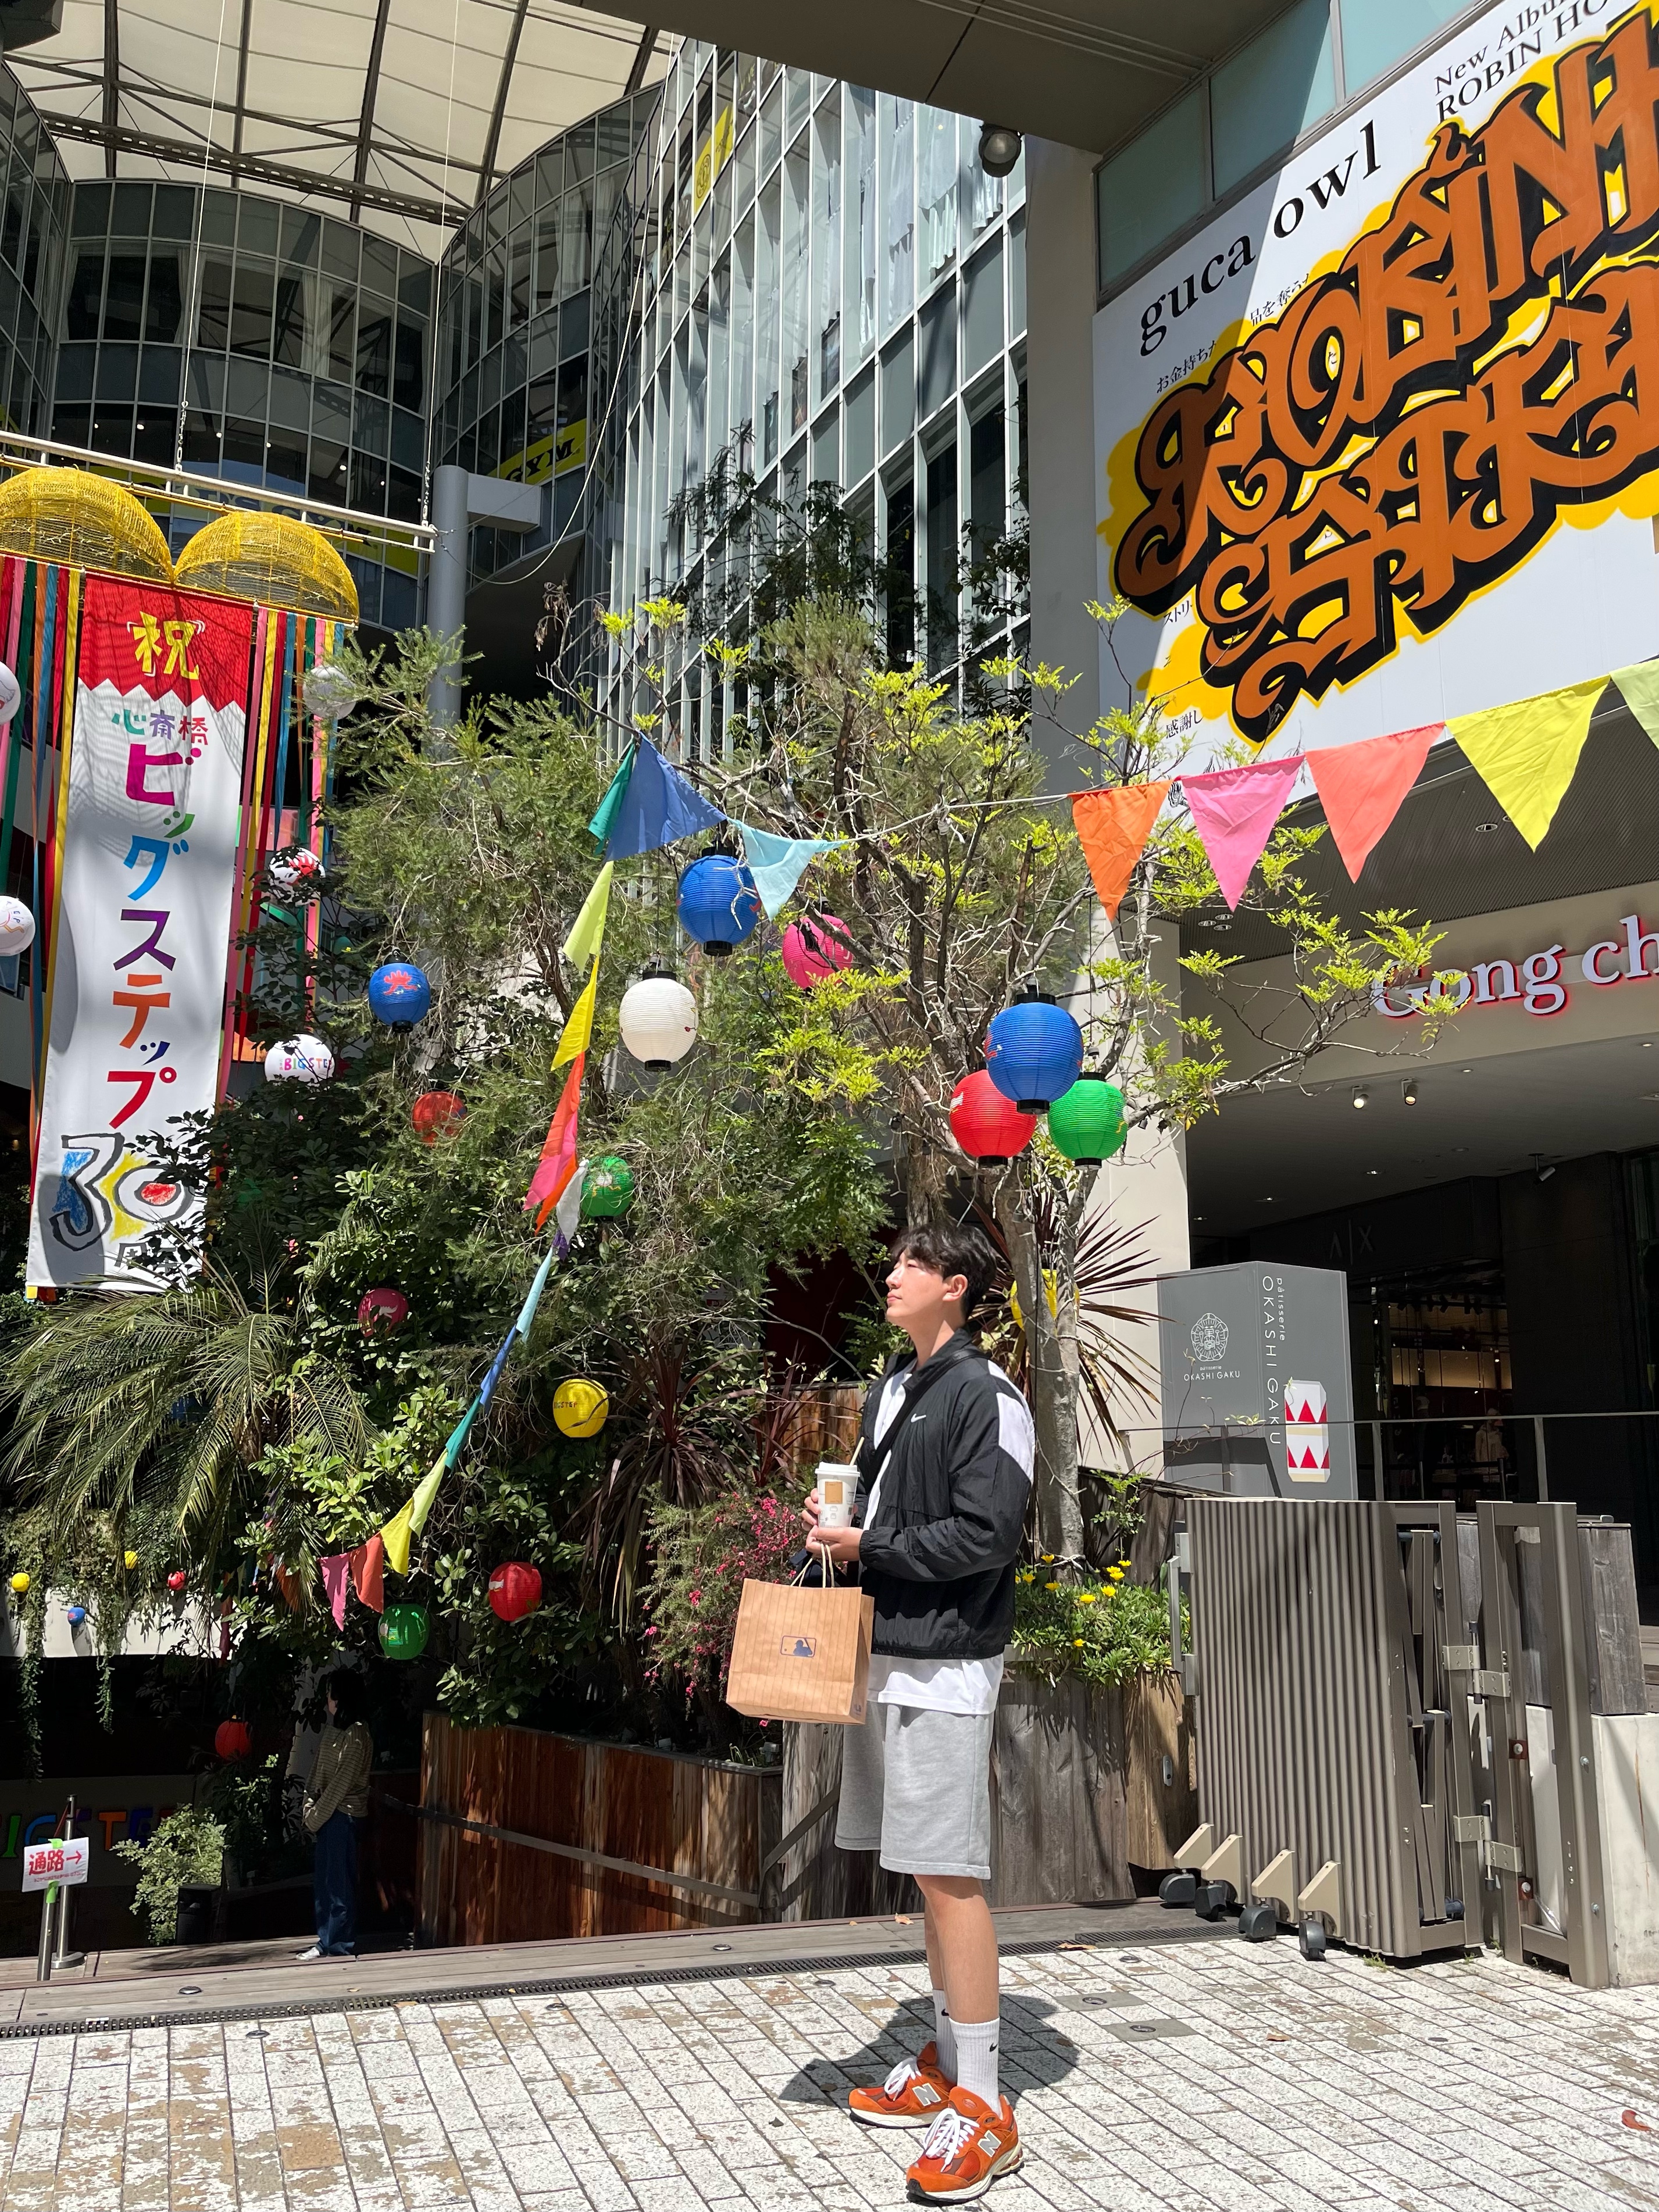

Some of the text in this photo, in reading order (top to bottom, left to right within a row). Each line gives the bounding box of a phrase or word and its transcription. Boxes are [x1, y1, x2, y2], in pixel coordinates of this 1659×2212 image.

[1435, 0, 1565, 96] New Albu
[1436, 27, 1543, 124] ROBIN
[1140, 119, 1381, 357] guca owl
[131, 610, 200, 680] 祝
[1164, 600, 1194, 627] ストリ
[111, 708, 209, 746] 心斎橋
[107, 743, 202, 1129] ビッグステップ
[1373, 944, 1565, 1017] Gong
[1183, 1370, 1241, 1381] OKASHI GAKU
[1262, 1275, 1281, 1444] OKASHI GAKU
[28, 1849, 65, 1876] 通路
[912, 2082, 942, 2107] N
[977, 2129, 1002, 2158] N
